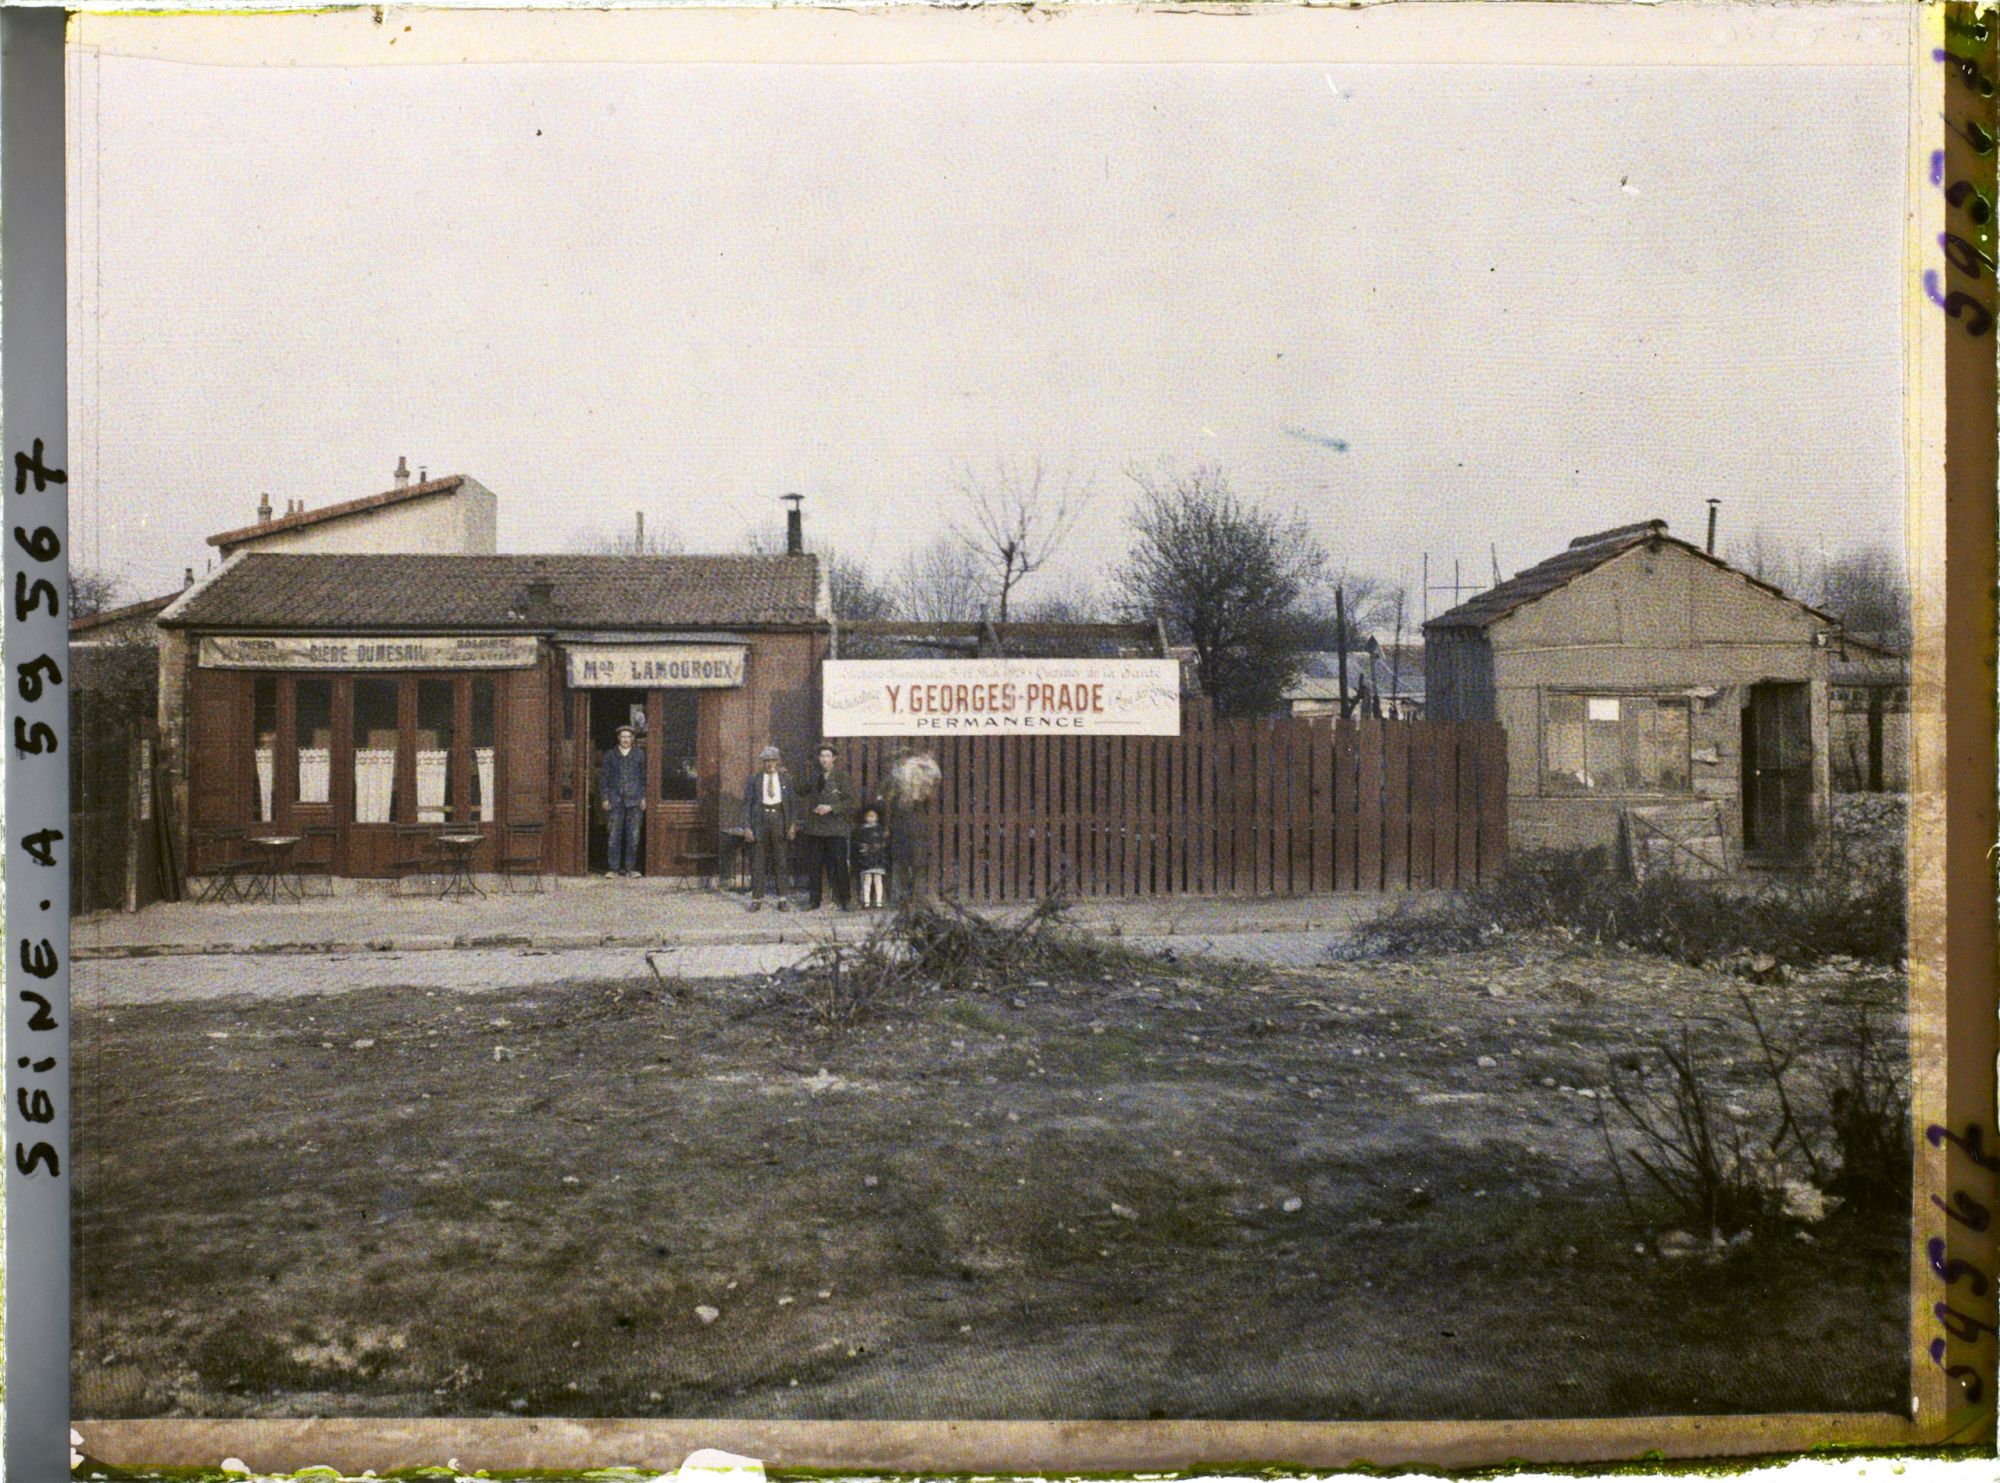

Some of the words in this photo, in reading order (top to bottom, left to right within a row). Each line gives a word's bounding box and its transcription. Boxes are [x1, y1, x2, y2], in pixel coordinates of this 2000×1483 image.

[15, 438, 66, 757] 59567
[631, 660, 732, 680] LAMOUROUX
[917, 716, 1085, 728] PERMANENCE
[21, 829, 61, 867] A
